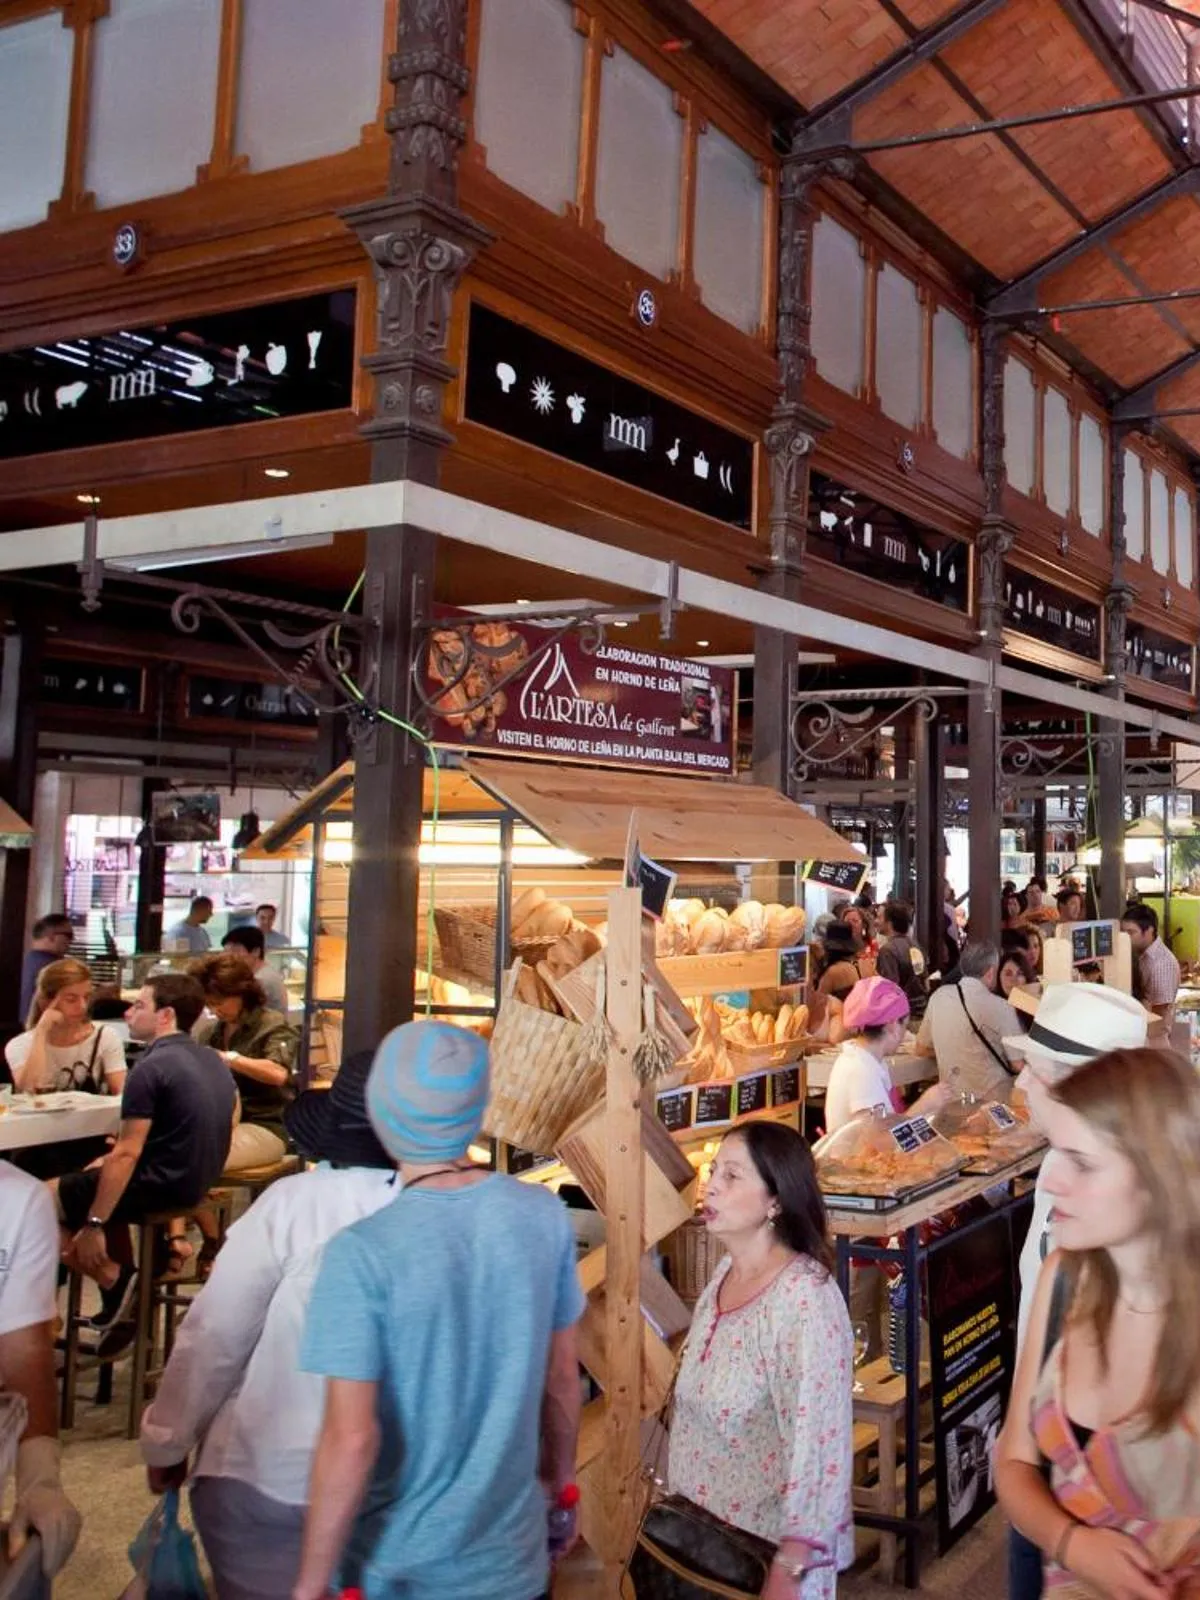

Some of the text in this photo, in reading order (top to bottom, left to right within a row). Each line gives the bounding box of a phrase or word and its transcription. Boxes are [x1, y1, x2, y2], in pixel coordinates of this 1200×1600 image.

[595, 667, 681, 693] EN HORNO DE LEÑA
[660, 657, 711, 679] TRADICIONAL
[620, 713, 634, 731] de
[497, 729, 730, 769] VISITEN EL HORNO DE LEÑA EN LA PLANTA BAJA DEL MERCADO
